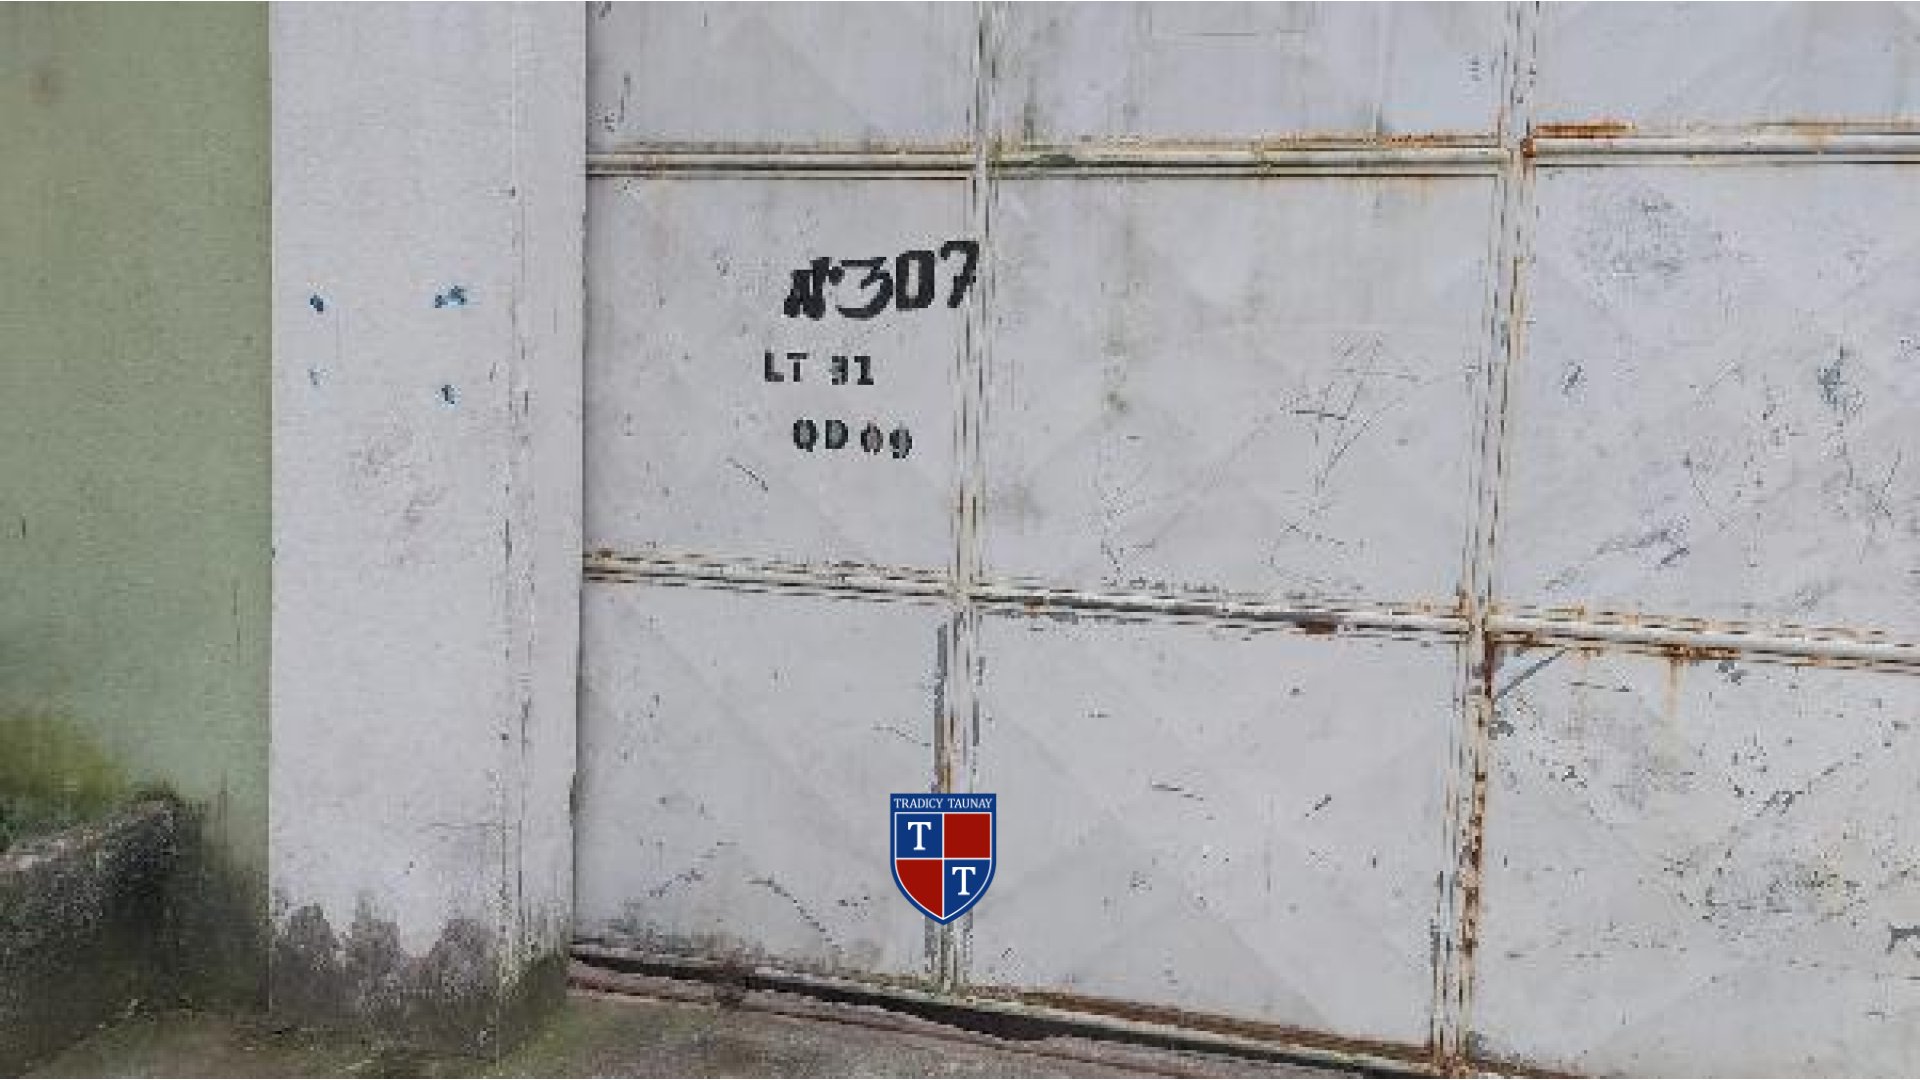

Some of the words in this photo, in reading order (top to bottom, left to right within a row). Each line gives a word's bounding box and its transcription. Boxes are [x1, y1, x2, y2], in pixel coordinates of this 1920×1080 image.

[764, 352, 807, 382] LT
[793, 420, 848, 452] QD
[861, 422, 912, 458] 09
